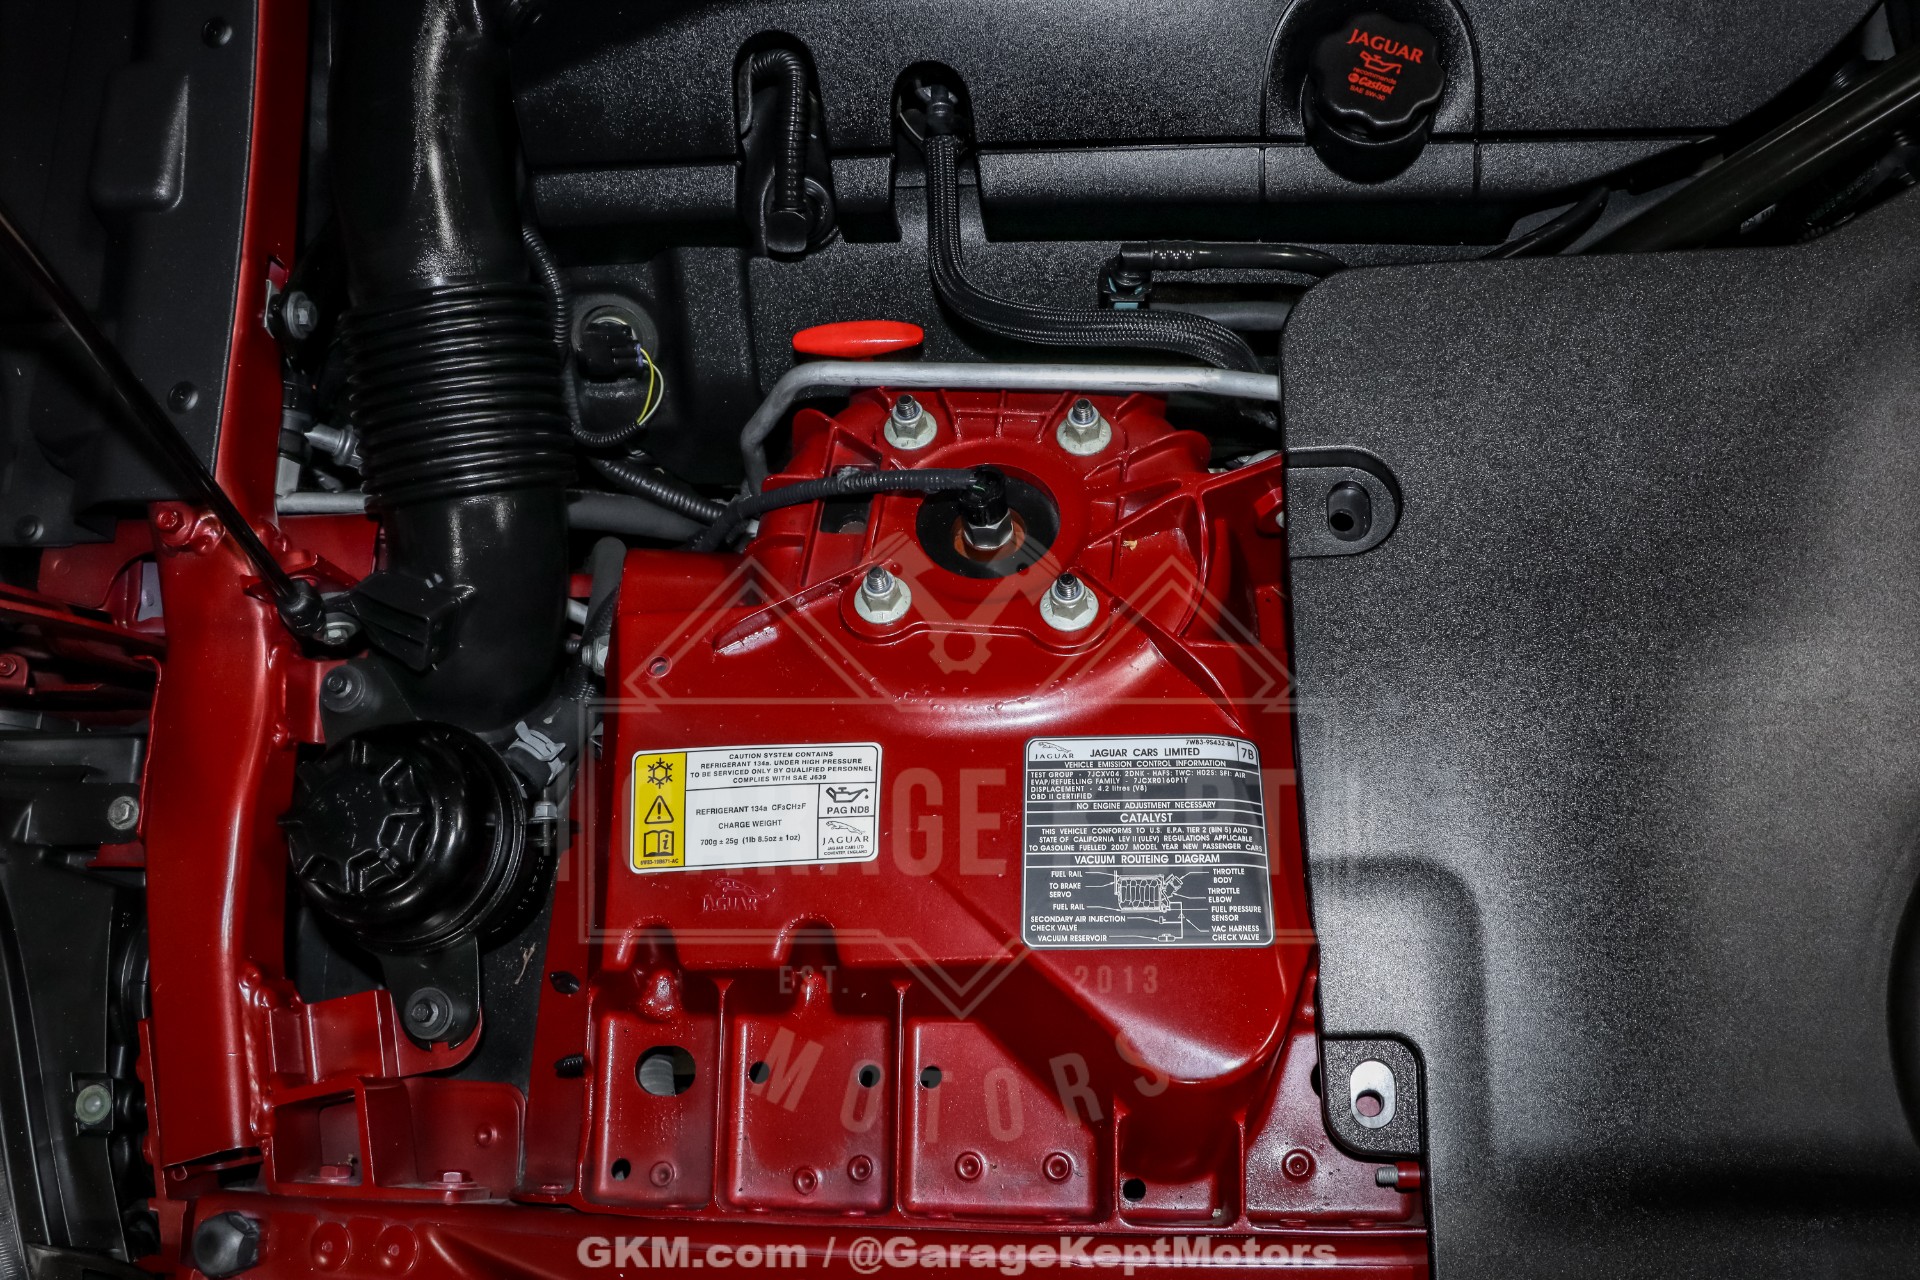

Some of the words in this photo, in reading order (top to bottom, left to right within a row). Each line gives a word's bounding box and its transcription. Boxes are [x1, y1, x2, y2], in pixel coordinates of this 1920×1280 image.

[1346, 29, 1423, 64] JAGUAR
[1350, 85, 1363, 94] SAE
[1359, 77, 1394, 94] Castrol
[1090, 749, 1128, 758] JAGUAR
[1133, 749, 1158, 757] CARS
[1164, 748, 1200, 757] LIMITED
[1242, 748, 1254, 760] 7B
[701, 761, 751, 769] REFRIGERANT
[1137, 760, 1172, 768] CONTROL
[733, 776, 770, 784] COMPLIES
[1031, 785, 1085, 793] DISPLACEMENT
[1133, 785, 1147, 793] (V8)
[1175, 801, 1216, 809] NECESSARY
[696, 806, 749, 816] REFRIGERANT
[826, 806, 848, 815] PAG
[850, 805, 870, 814] ND8
[1120, 813, 1173, 823] CATALYST
[719, 821, 750, 830] CHARGE
[752, 820, 782, 828] WEIGHT
[1208, 826, 1223, 834] (BIN
[701, 838, 718, 847] 700g
[726, 837, 738, 846] 25g
[757, 834, 777, 843] 8.5oz
[823, 836, 869, 846] JAGUAR
[1073, 835, 1115, 843] CALIFORNIA
[1138, 835, 1160, 843] (ULEV)
[1164, 834, 1210, 842] REGULATIONS
[1075, 856, 1115, 864] VACUUM
[1122, 855, 1169, 864] ROUTEING
[1175, 855, 1220, 864] DIAGRAM
[1076, 915, 1087, 923] AIR
[1088, 915, 1126, 923] INJECTION
[1057, 924, 1078, 932] VALVE
